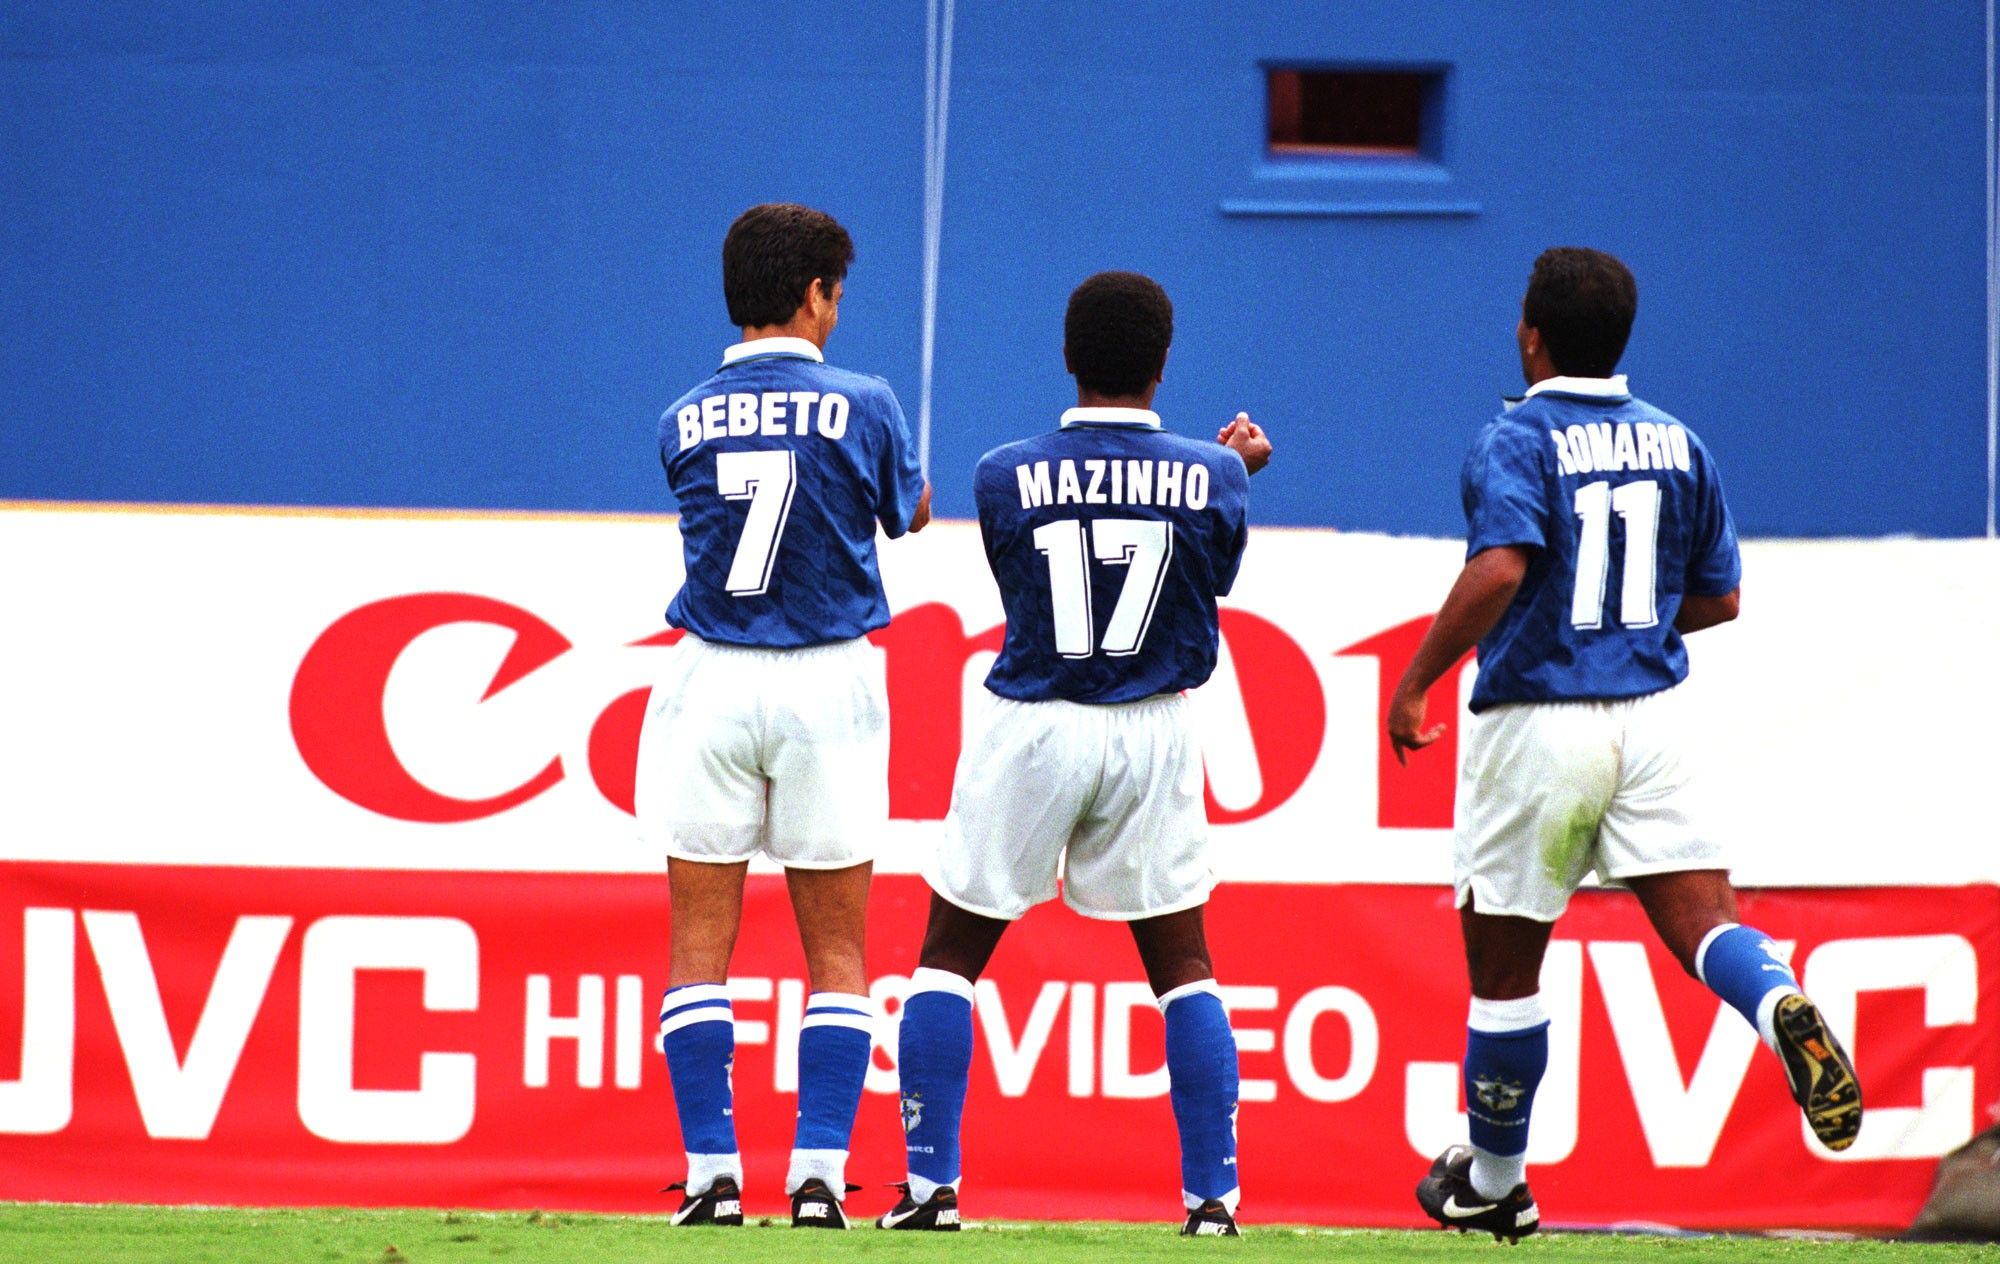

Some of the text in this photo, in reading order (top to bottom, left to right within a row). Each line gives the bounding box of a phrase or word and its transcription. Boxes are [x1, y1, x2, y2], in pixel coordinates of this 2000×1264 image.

[677, 391, 850, 451] BEBETO
[1550, 422, 1691, 477] ROMARIO
[716, 449, 797, 597] 7
[1015, 459, 1210, 511] MAZINHO
[1032, 518, 1174, 660] 17
[1570, 480, 1662, 631] 11
[0, 907, 482, 1145] JVC
[523, 973, 806, 1094] HIFI
[972, 979, 1380, 1103] VIDEO
[1404, 932, 1981, 1168] JVC
[797, 1201, 830, 1219] NIKE
